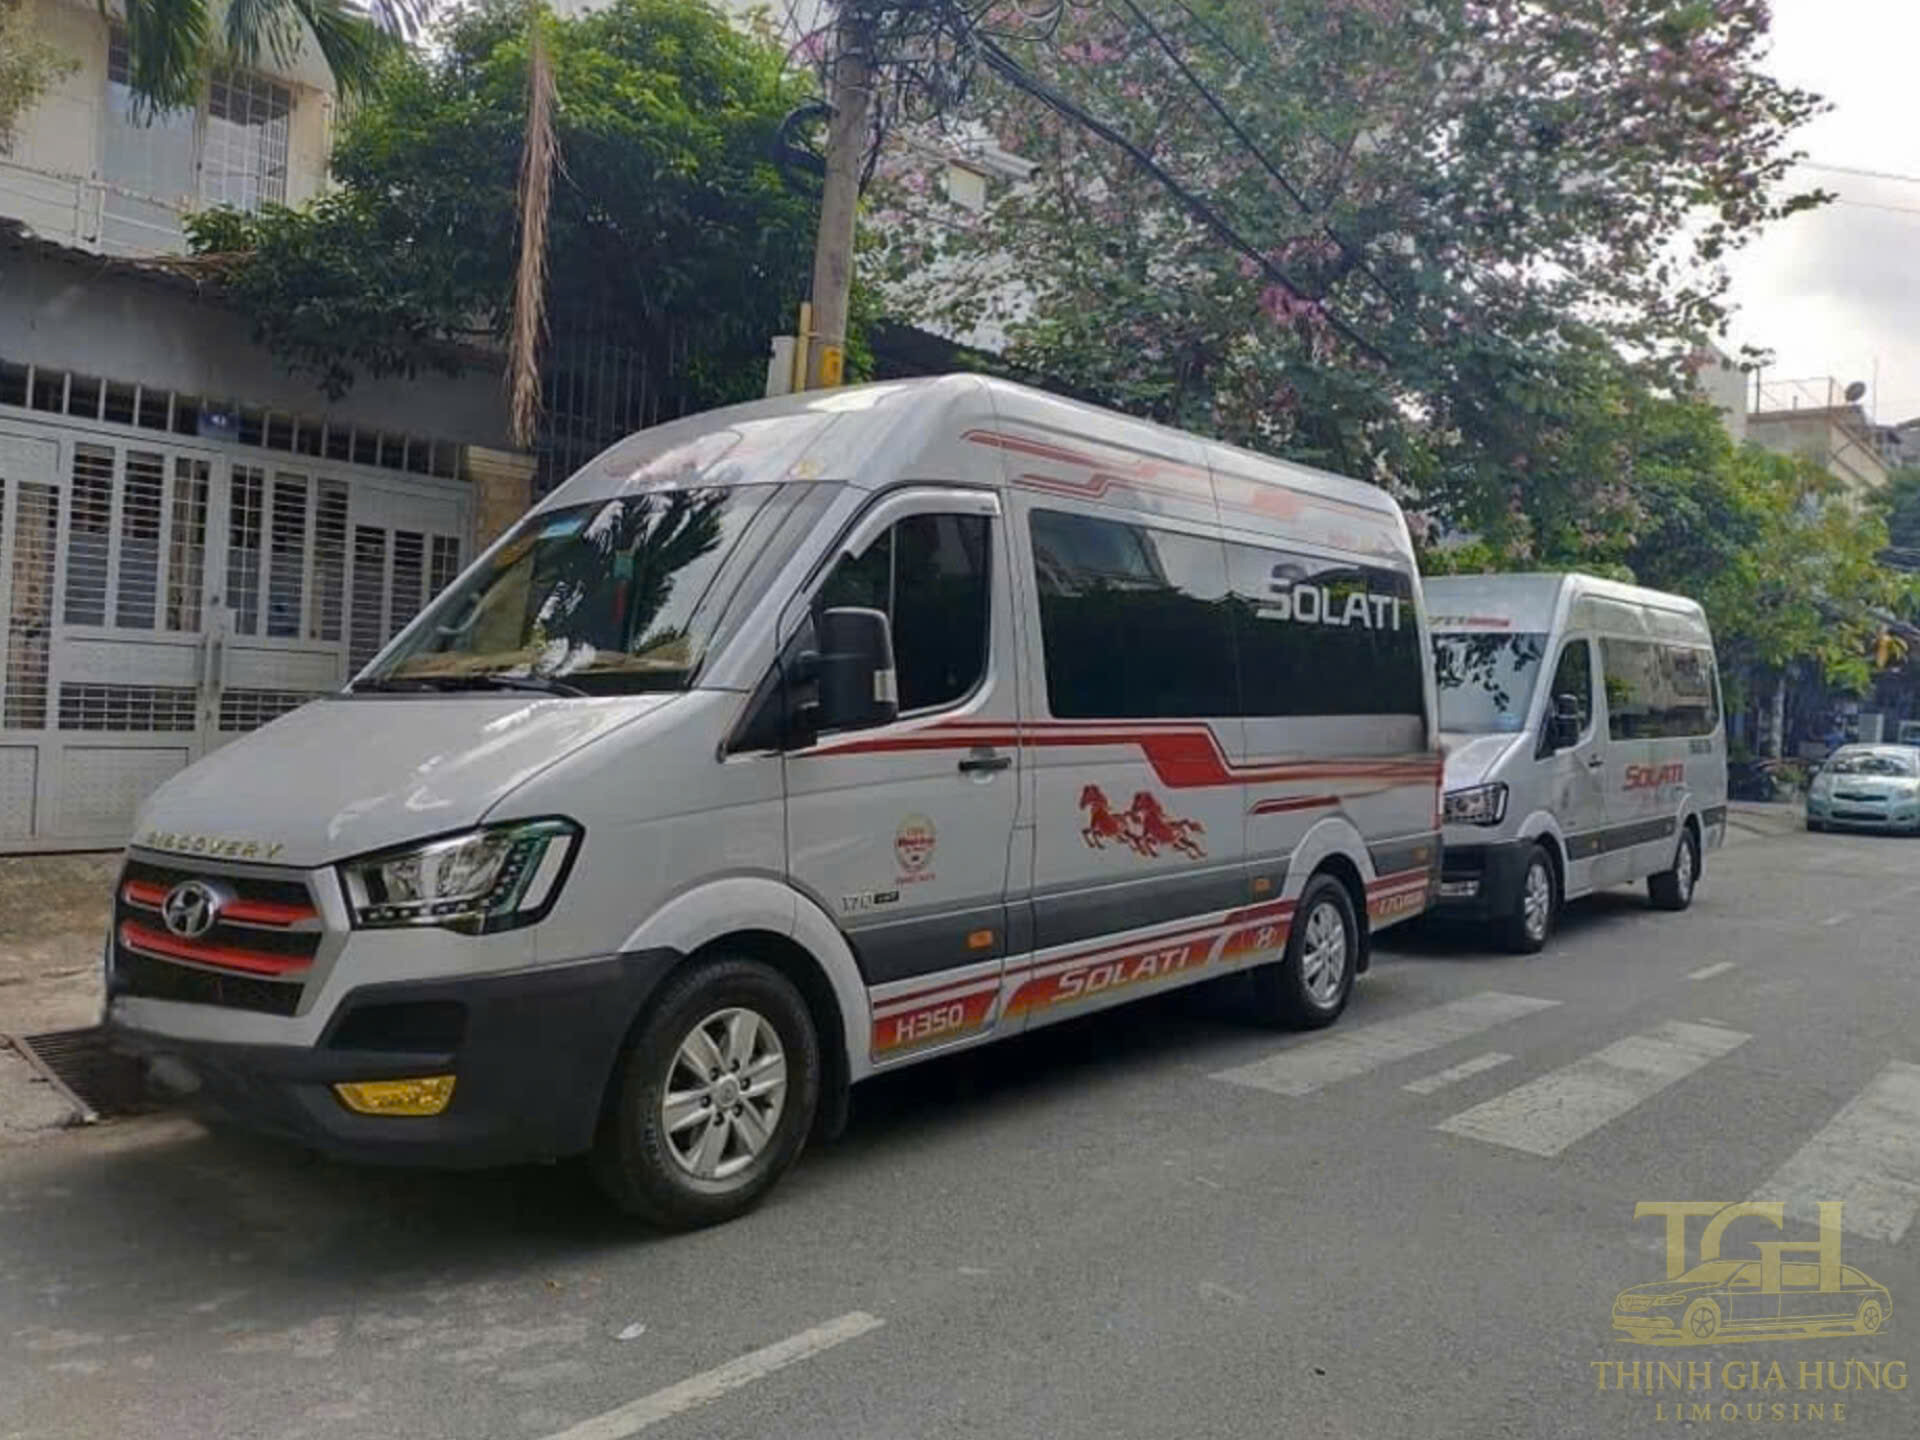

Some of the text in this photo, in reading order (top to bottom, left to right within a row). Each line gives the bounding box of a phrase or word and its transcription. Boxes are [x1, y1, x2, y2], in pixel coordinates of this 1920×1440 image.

[1256, 573, 1400, 631] SOLATI
[1622, 763, 1685, 790] SOLATI
[1054, 947, 1191, 1000] SOLATI
[896, 1004, 965, 1043] H350
